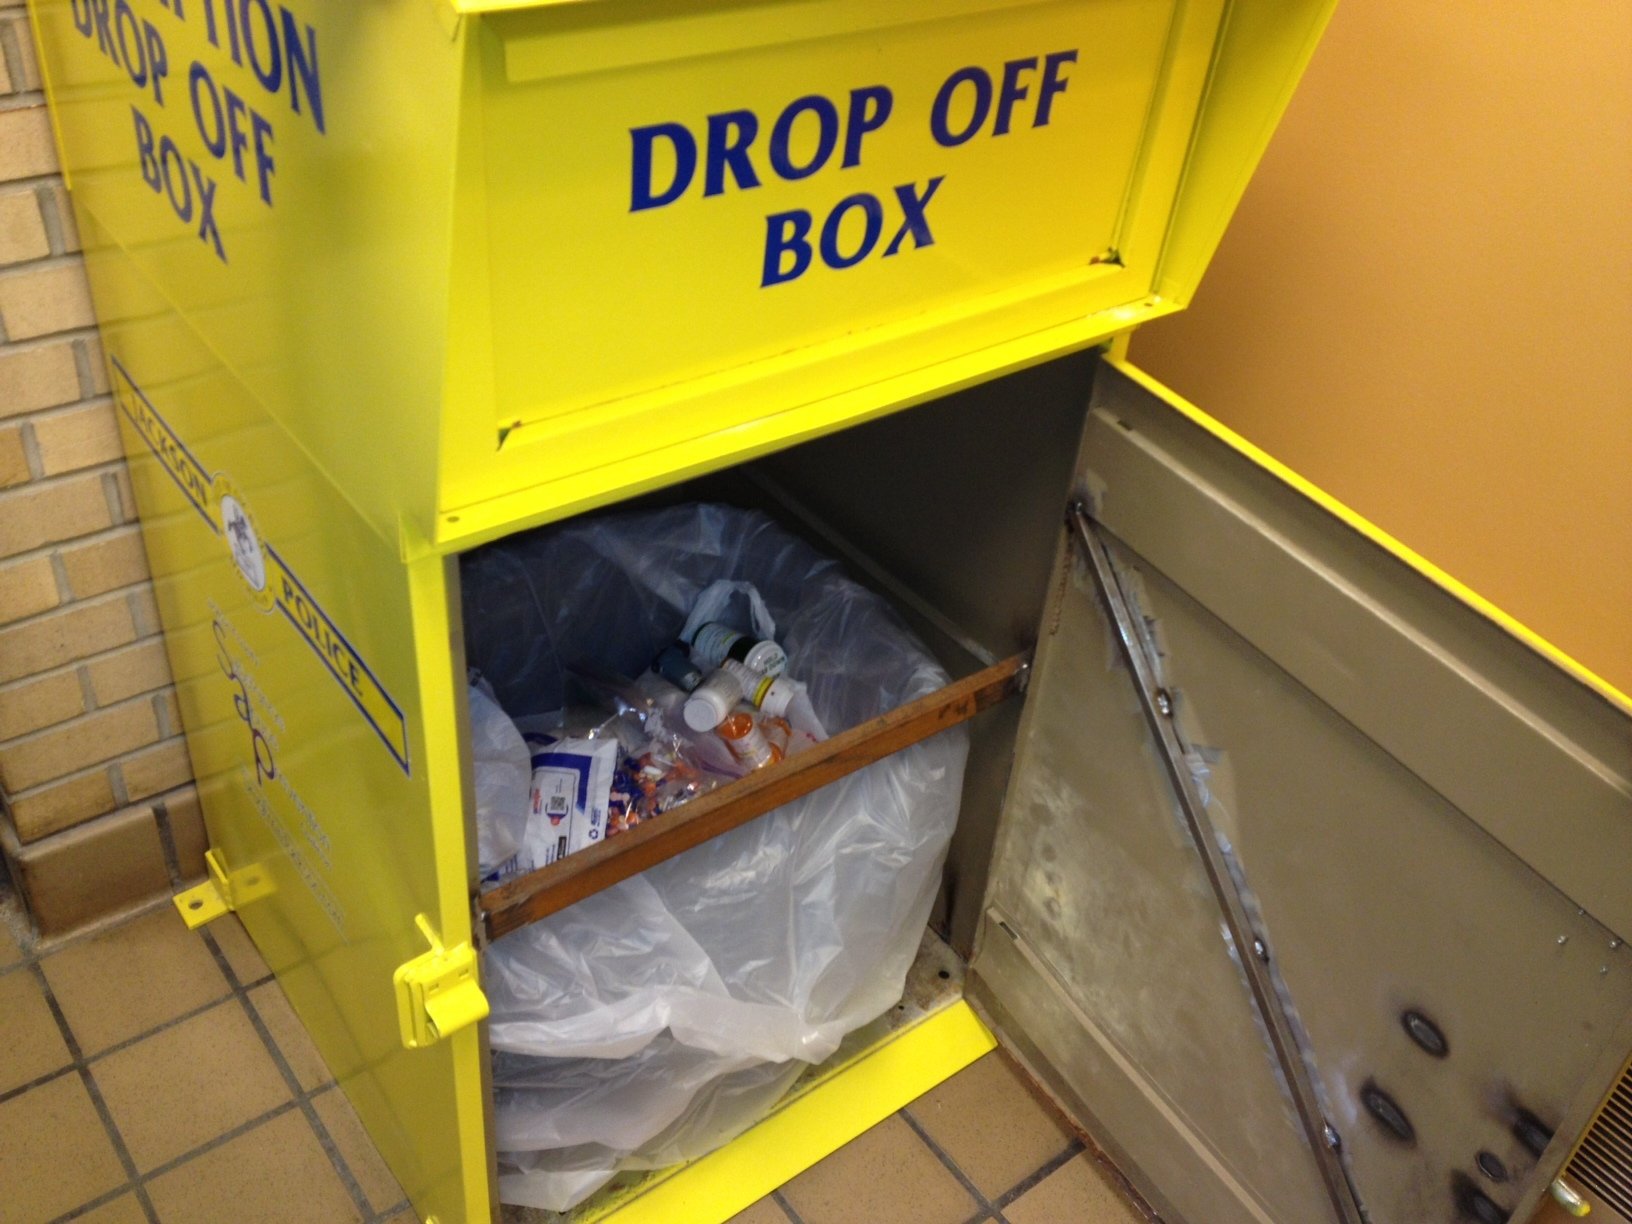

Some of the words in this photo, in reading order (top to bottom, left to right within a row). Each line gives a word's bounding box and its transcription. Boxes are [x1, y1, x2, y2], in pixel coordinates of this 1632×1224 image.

[160, 0, 326, 136] ION
[189, 60, 276, 208] OFF
[628, 85, 894, 213] DROP
[929, 48, 1079, 148] OFF
[131, 104, 228, 266] BOX
[759, 174, 946, 288] BOX
[281, 574, 364, 698] POLICE
